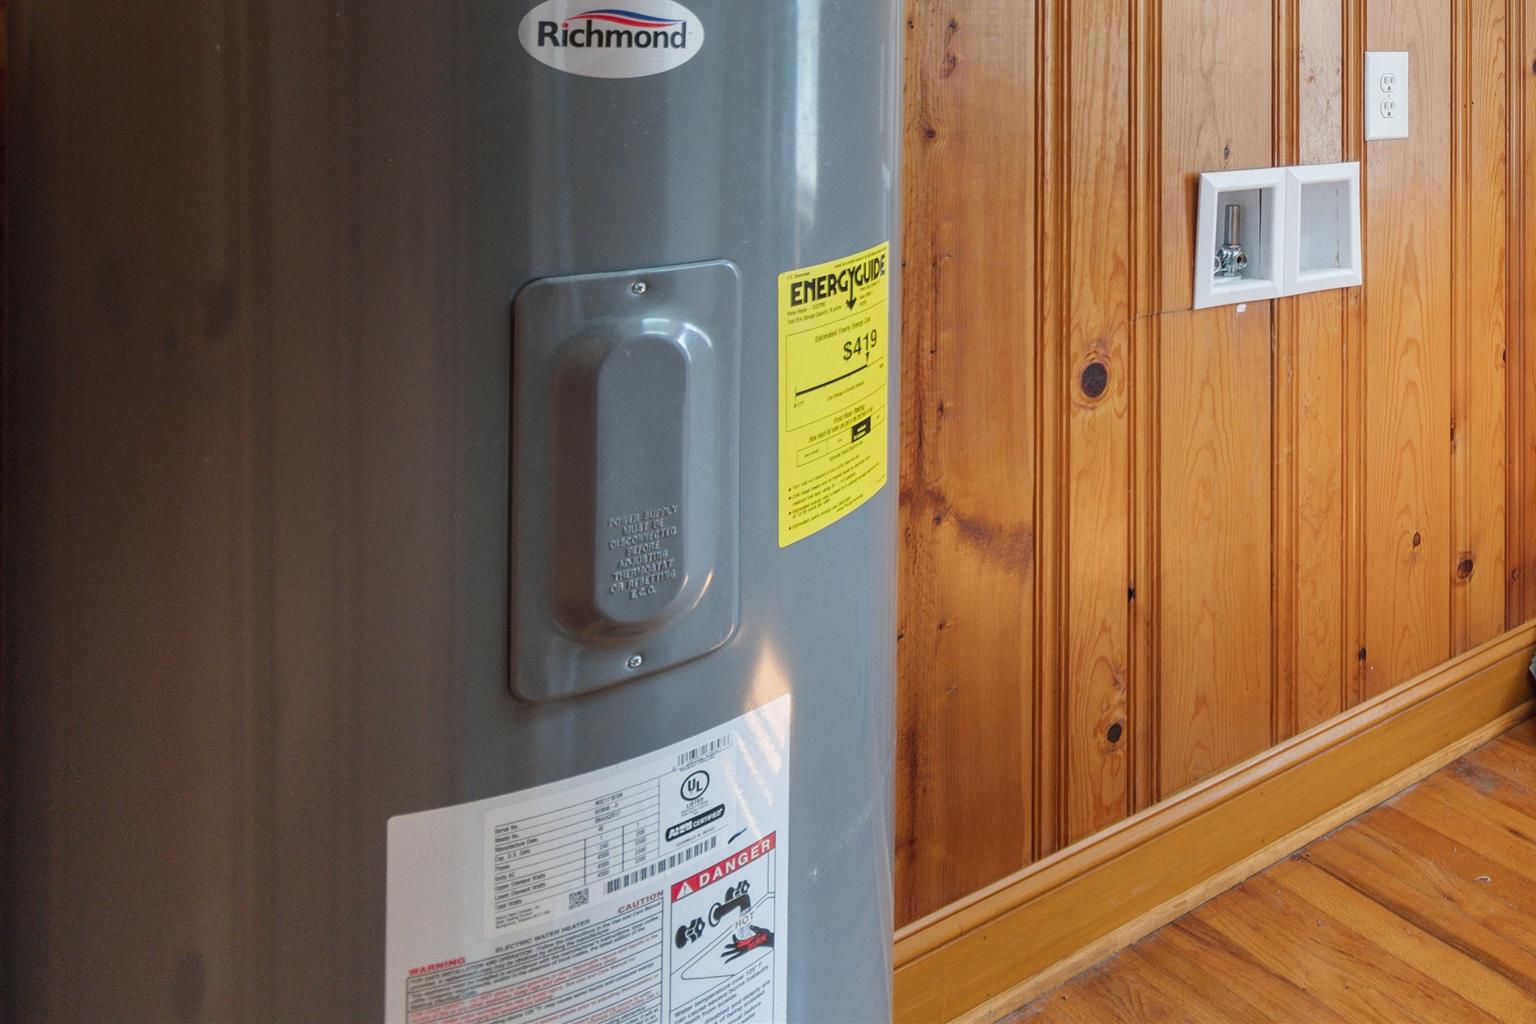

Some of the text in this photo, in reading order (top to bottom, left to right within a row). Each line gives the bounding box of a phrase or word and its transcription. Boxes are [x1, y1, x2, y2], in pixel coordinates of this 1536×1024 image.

[537, 19, 687, 49] Richmond
[790, 253, 886, 308] ENERGYGUIDE
[843, 328, 877, 361] $419
[608, 504, 678, 529] POWER SUPPLY
[608, 526, 678, 550] DISCONNECTED
[613, 559, 675, 582] THERMOSTAT
[688, 778, 703, 793] UL
[698, 838, 771, 887] DANGER
[618, 890, 664, 914] CAUTION
[534, 929, 560, 942] WATER
[561, 919, 591, 933] HEATER
[735, 912, 754, 929] HOT
[408, 957, 466, 976] WARNING
